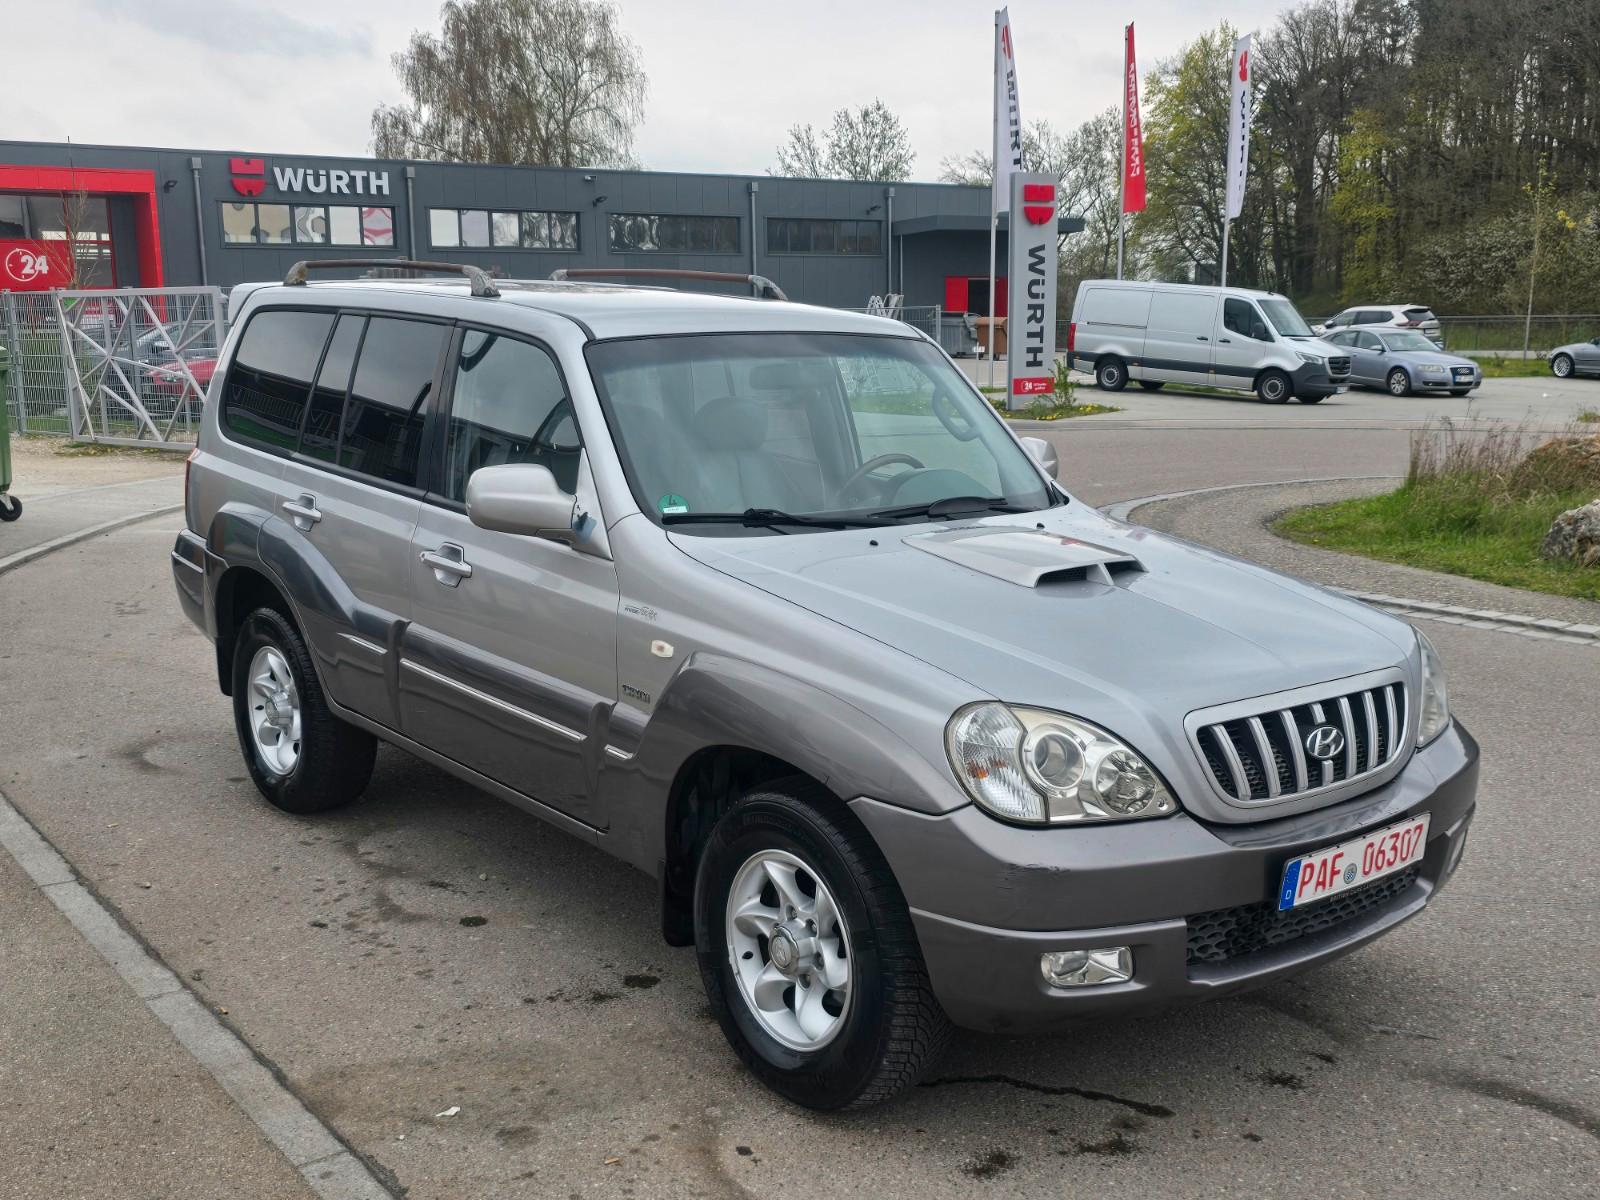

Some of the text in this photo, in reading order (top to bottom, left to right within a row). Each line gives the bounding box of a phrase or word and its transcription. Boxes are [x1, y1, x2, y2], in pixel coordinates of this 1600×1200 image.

[273, 167, 390, 195] WÜRTH
[20, 255, 49, 274] 24
[1026, 244, 1046, 367] WÜRTH
[1298, 851, 1344, 898] PAF
[1362, 823, 1424, 876] 06307
[1285, 889, 1292, 900] D
